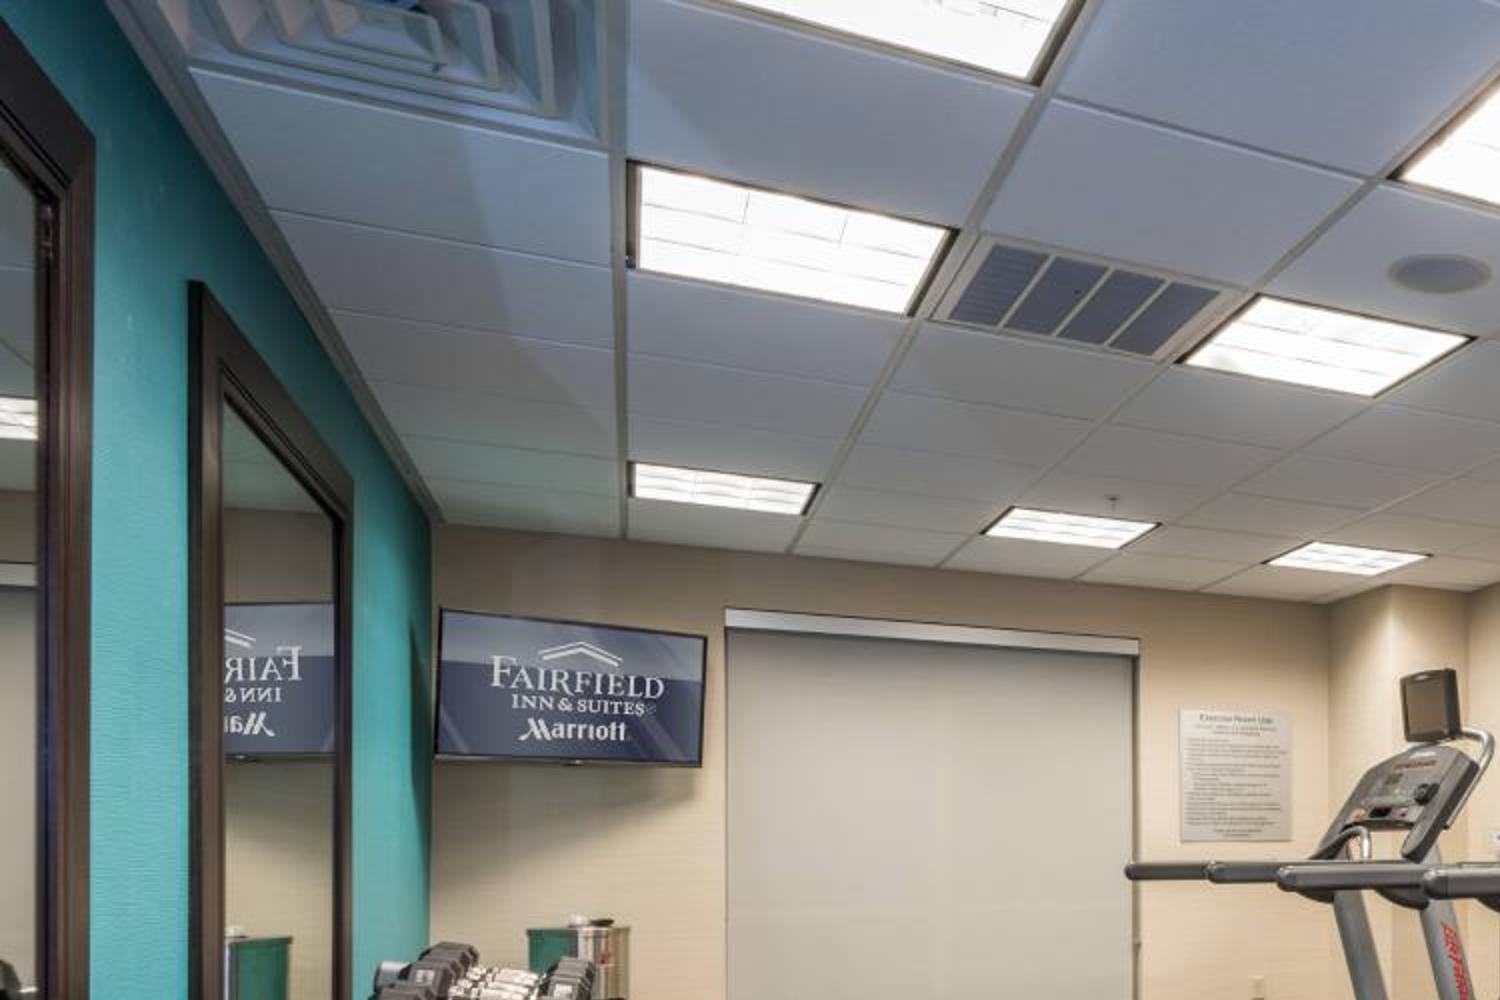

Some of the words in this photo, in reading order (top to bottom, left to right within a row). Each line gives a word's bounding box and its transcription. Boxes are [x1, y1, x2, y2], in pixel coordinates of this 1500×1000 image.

[490, 655, 665, 699] FAIRFIELD
[512, 693, 555, 711] INN
[558, 697, 573, 712] &
[577, 699, 645, 717] SUITES
[518, 717, 627, 741] Marriott
